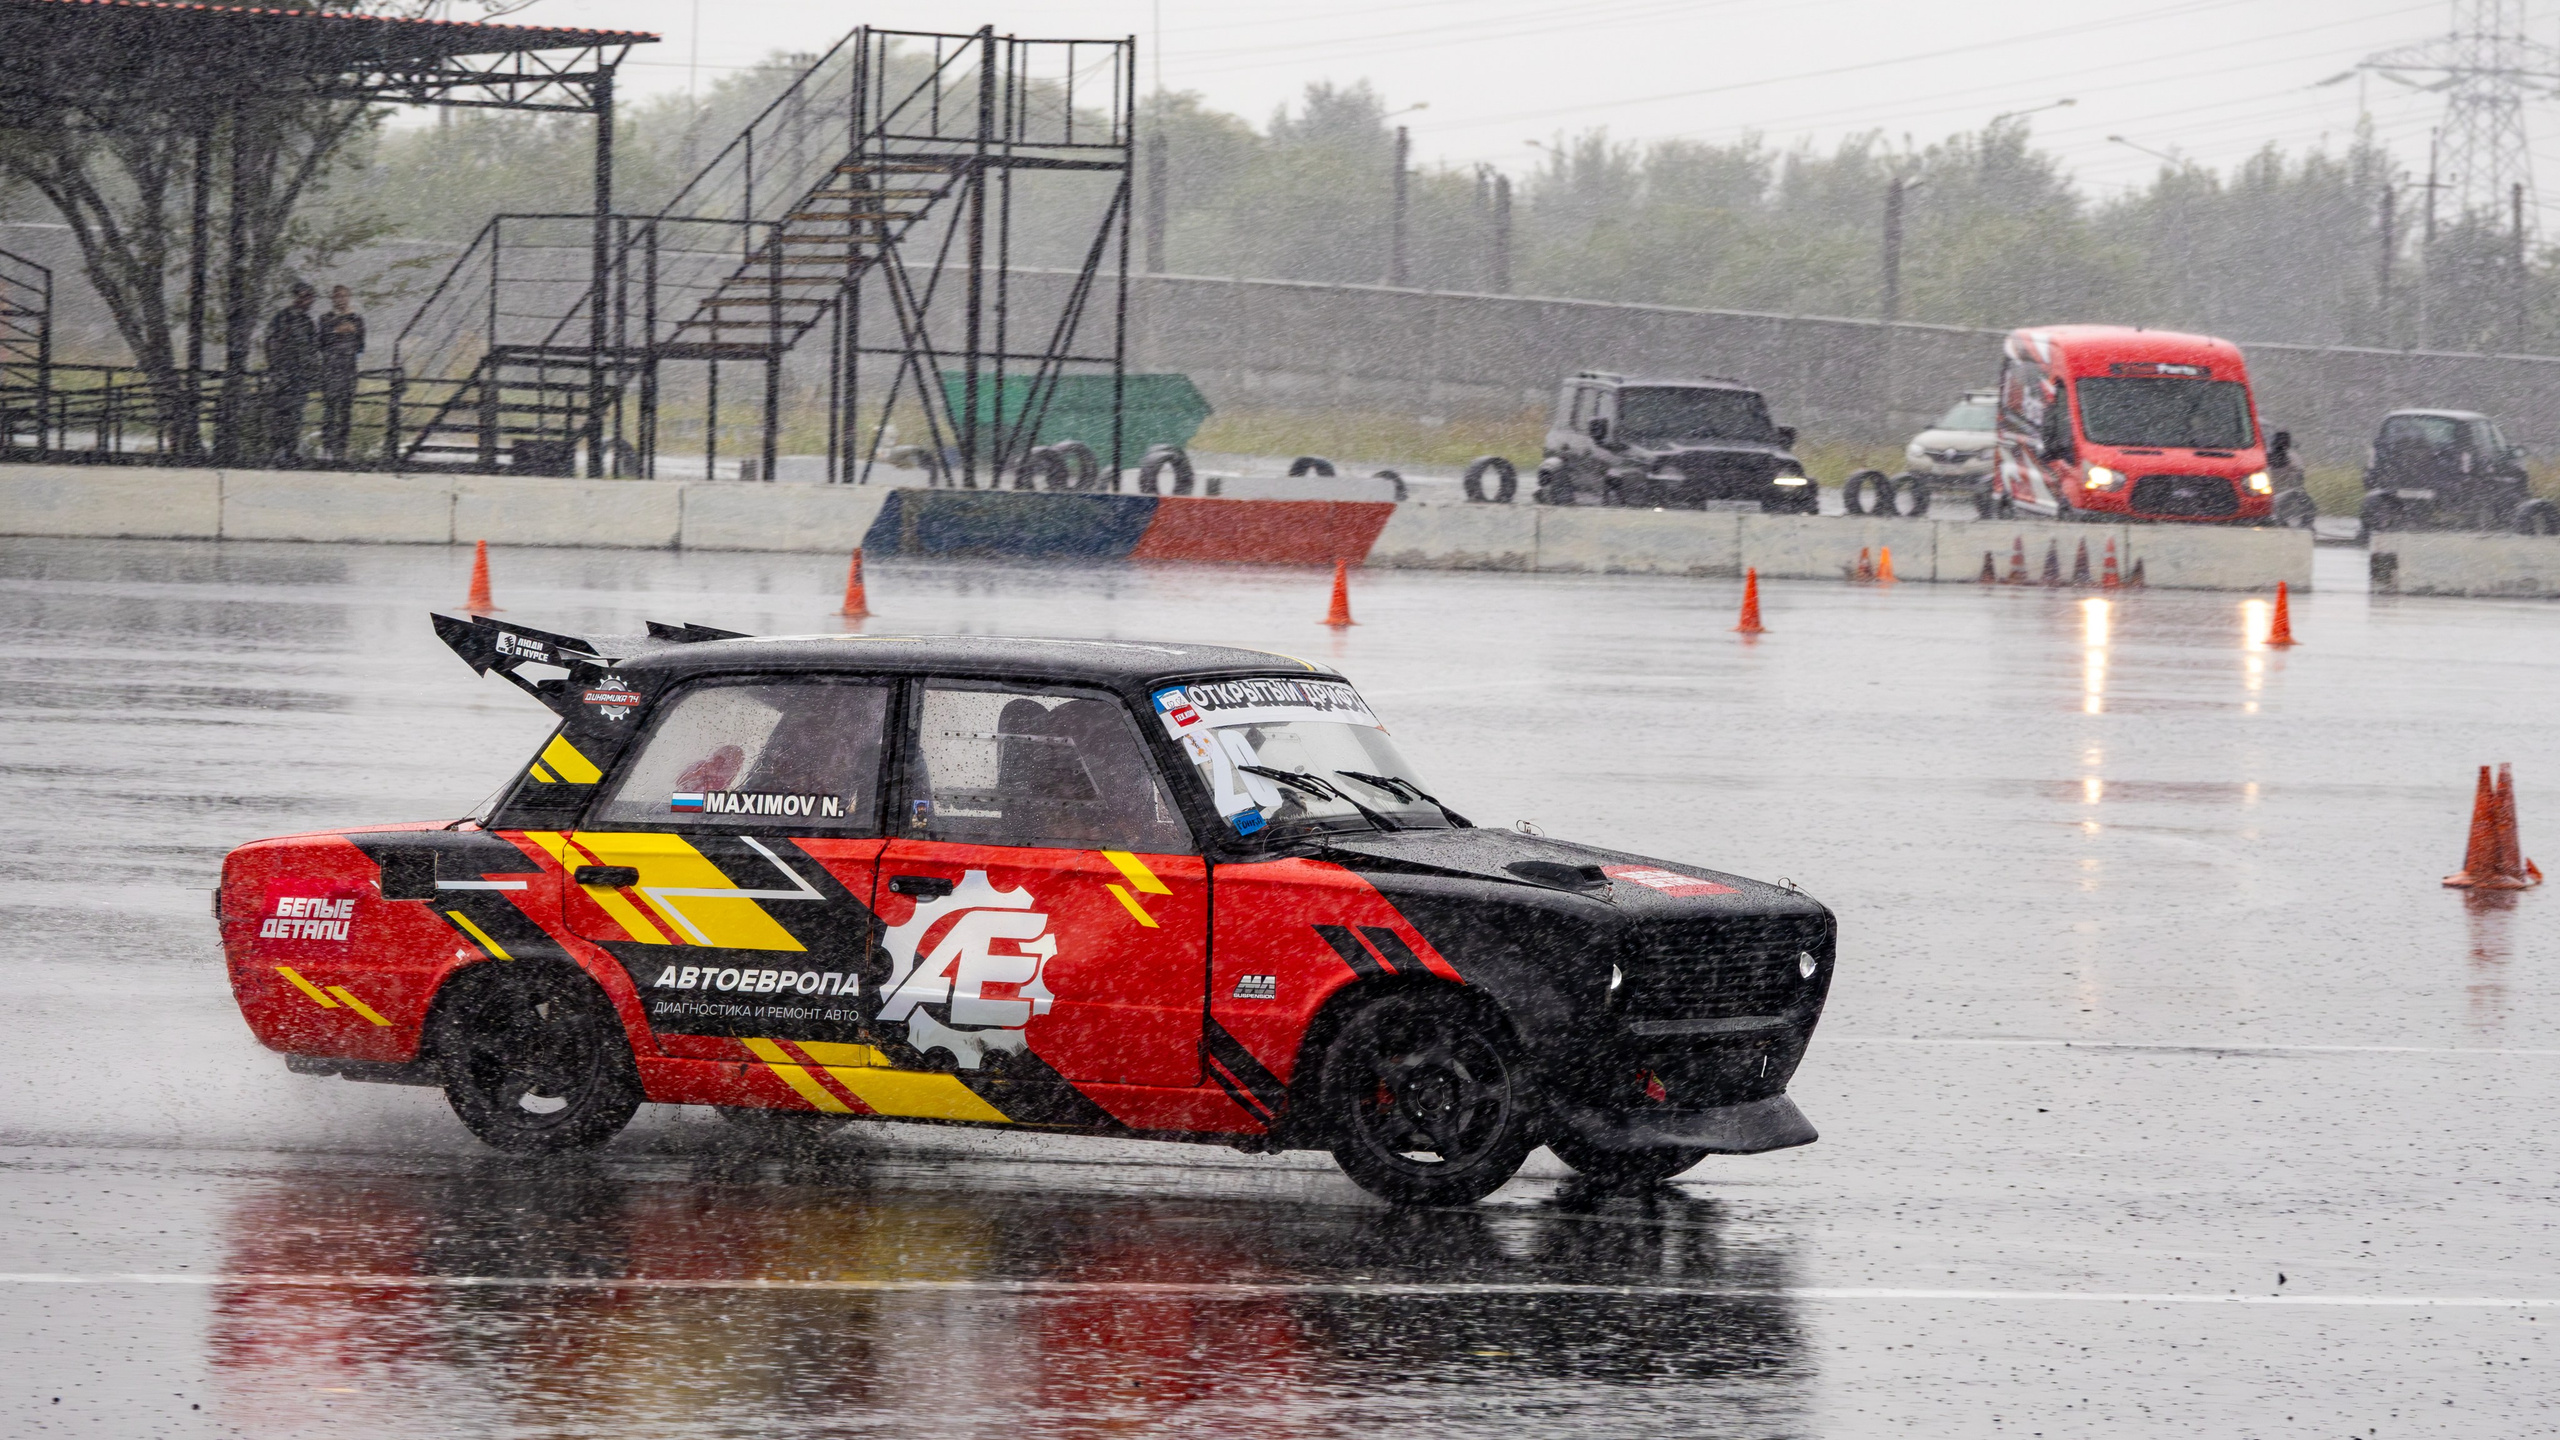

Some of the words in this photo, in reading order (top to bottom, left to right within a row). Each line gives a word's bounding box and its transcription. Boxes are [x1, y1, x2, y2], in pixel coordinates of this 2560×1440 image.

[515, 648, 522, 656] В
[523, 649, 550, 662] КУРСЕ
[517, 637, 544, 651] ЛЮДИ
[584, 693, 628, 702] ДИНАМИКА
[629, 694, 640, 703] 74
[1187, 679, 1305, 709] ОТКРЫТЫЙ
[1300, 682, 1361, 709] ДРИФТ
[706, 792, 816, 816] MAXIMOV
[821, 796, 844, 817] N.
[276, 897, 355, 919] БЕЛЫЕ
[259, 918, 350, 940] ДЕТАЛИ
[653, 965, 860, 996] АВТОЕВРОПА
[654, 1001, 751, 1017] ДИАГНОСТИКА
[755, 1005, 765, 1017] И
[768, 1006, 821, 1020] РЕМОНТ
[824, 1008, 859, 1021] АВТО
